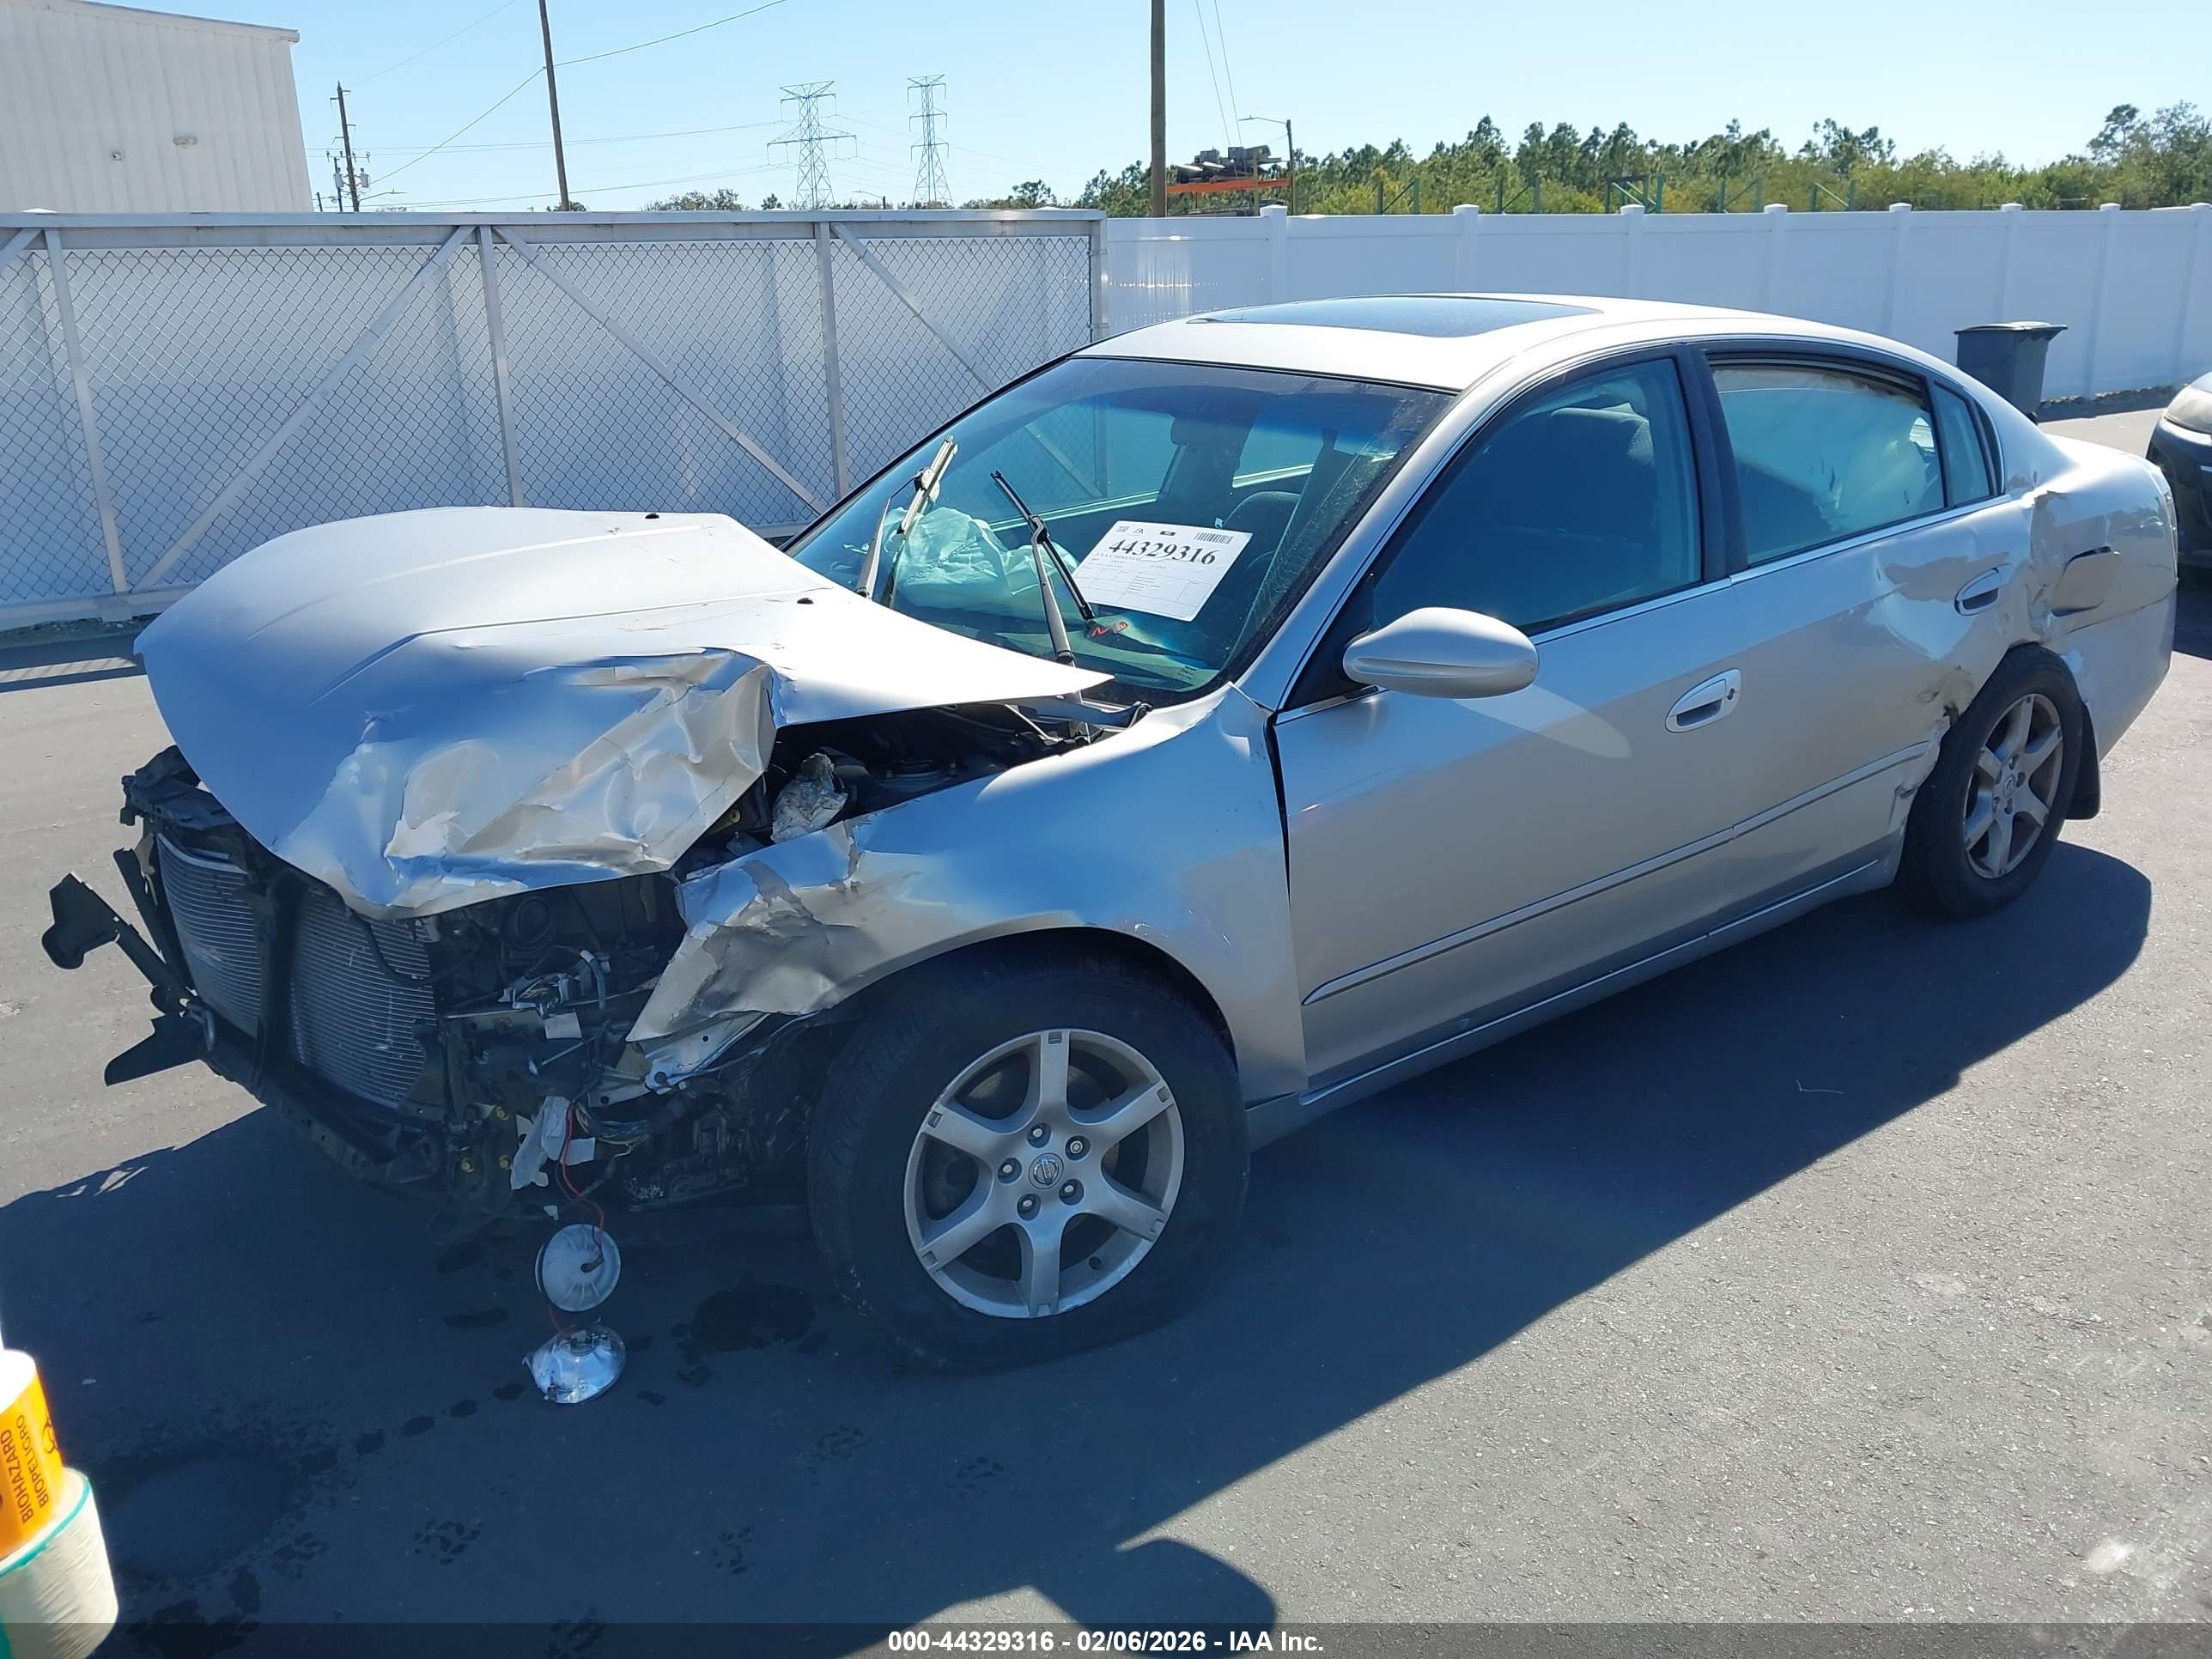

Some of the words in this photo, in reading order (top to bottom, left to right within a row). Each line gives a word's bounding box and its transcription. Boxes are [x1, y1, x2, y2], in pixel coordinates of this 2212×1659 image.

[1109, 539, 1223, 565] 44329316
[0, 1429, 33, 1523] BIOHAZARD
[16, 1414, 49, 1508] BIOPELIGRO
